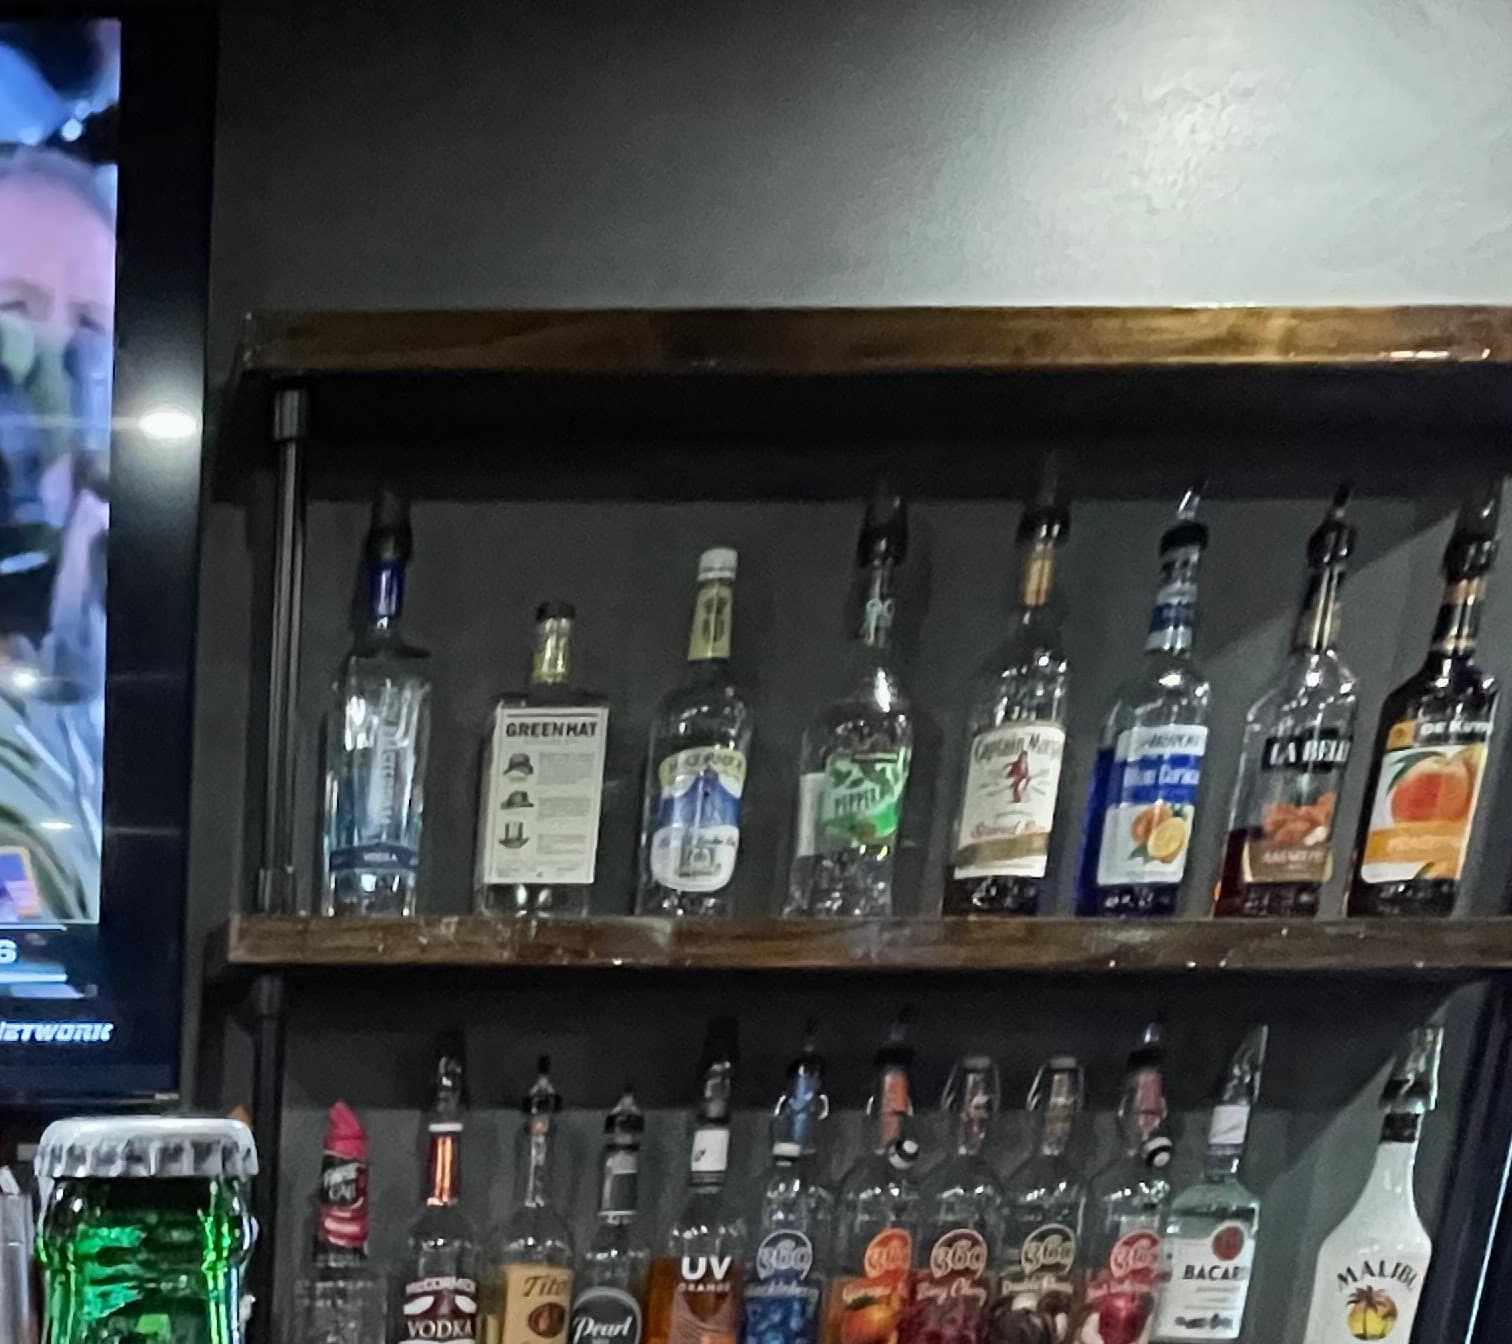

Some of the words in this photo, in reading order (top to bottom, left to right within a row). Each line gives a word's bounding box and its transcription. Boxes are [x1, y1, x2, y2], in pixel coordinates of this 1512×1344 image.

[506, 722, 564, 737] GREEN
[566, 722, 598, 737] HAT
[681, 1255, 732, 1281] UV
[407, 1321, 473, 1338] VODKA
